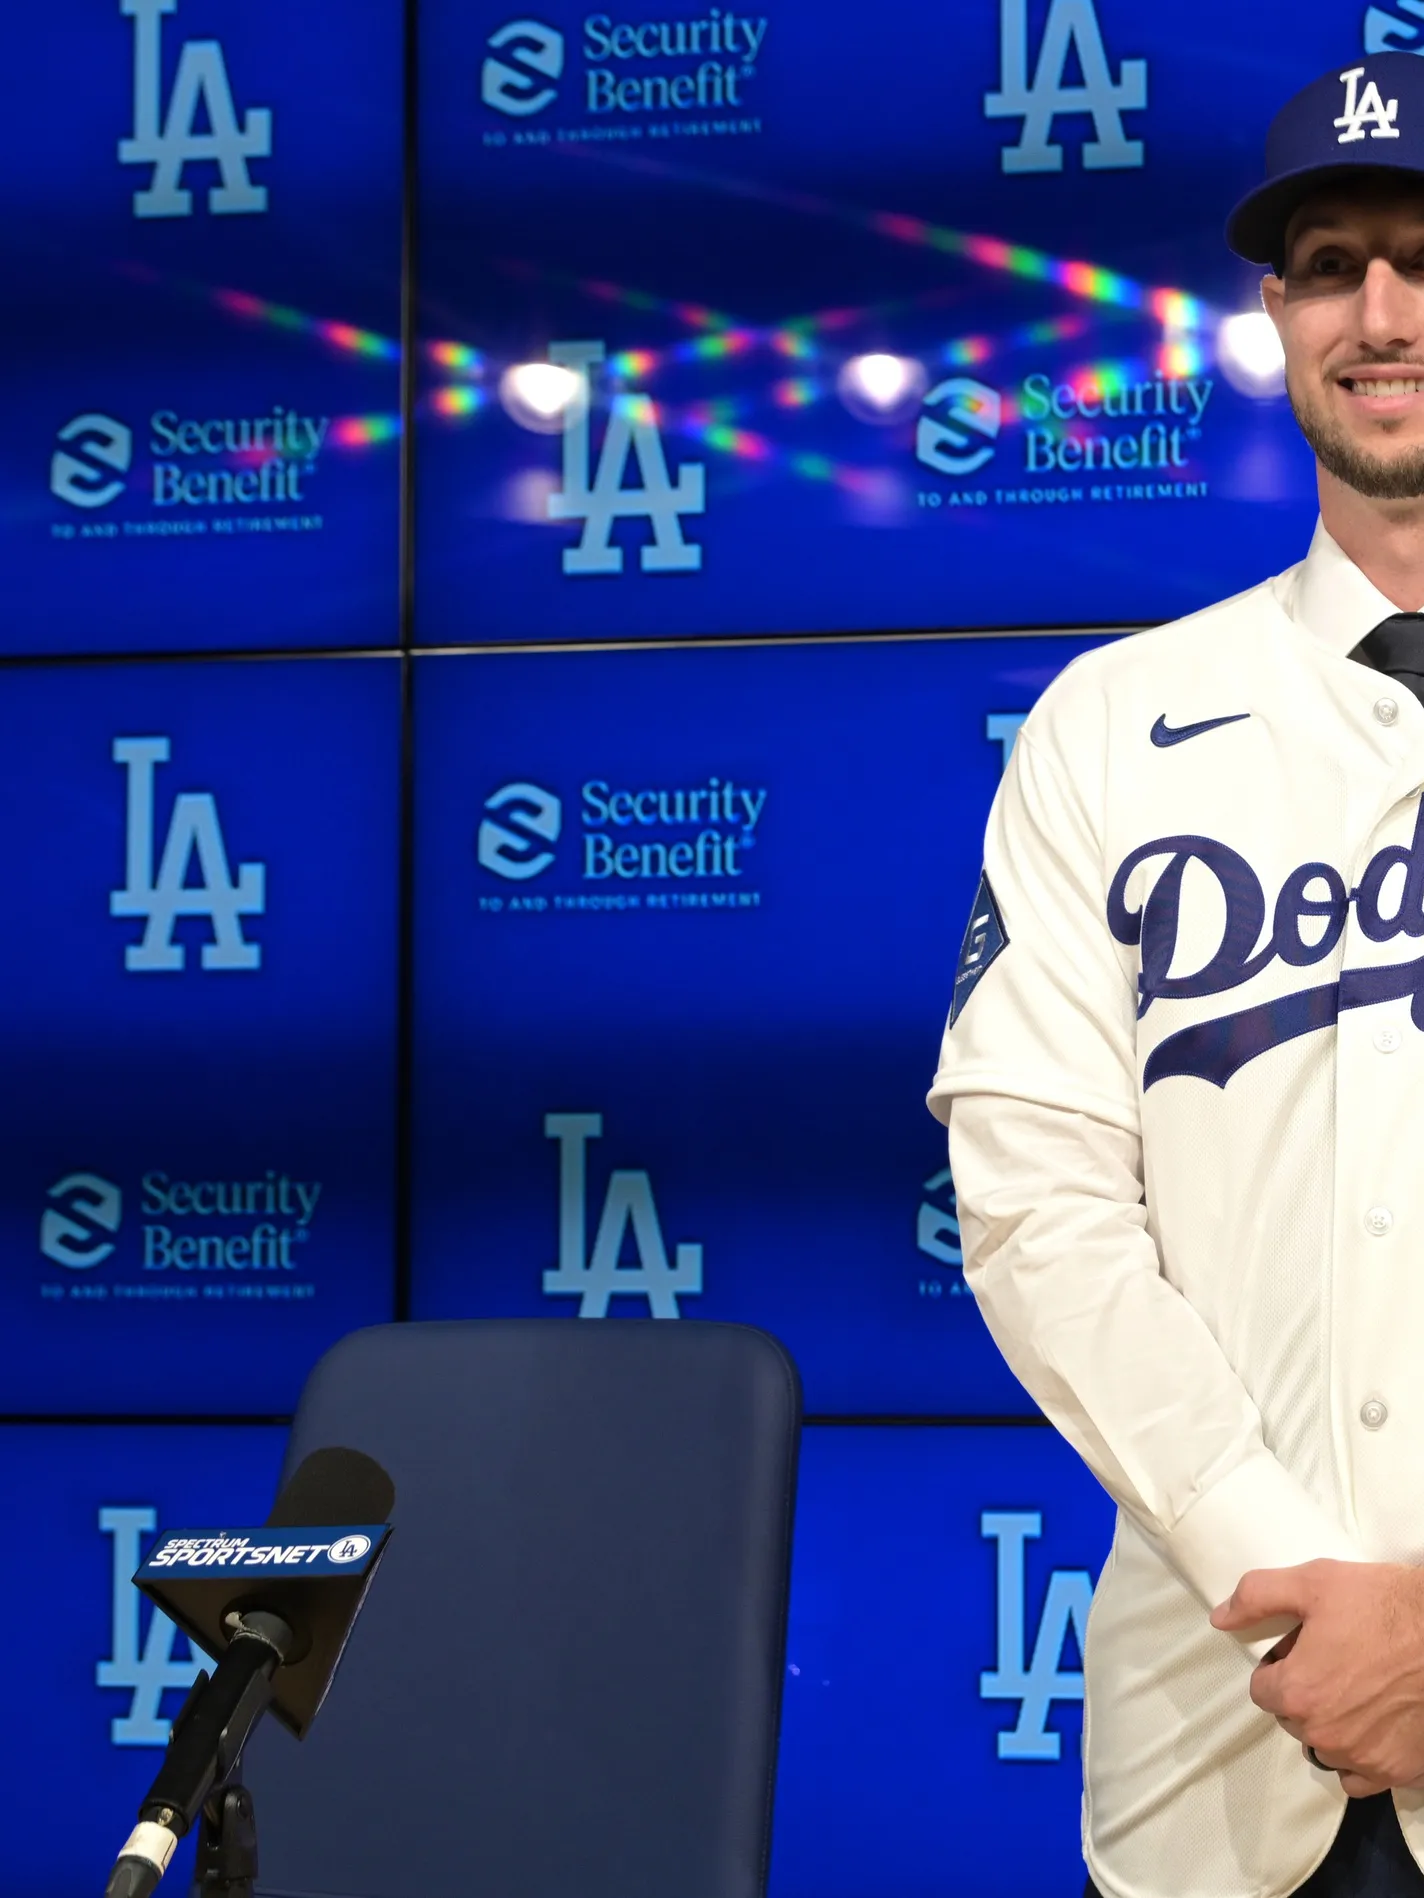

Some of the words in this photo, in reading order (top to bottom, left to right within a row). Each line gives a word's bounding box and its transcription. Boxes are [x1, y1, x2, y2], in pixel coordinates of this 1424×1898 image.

[584, 7, 768, 61] Security
[119, 0, 271, 217] LA
[1333, 66, 1400, 144] LA
[1022, 369, 1213, 424] Security
[151, 405, 329, 459] Security
[548, 342, 704, 573] LA
[917, 491, 941, 507] TO
[949, 490, 987, 506] AND
[996, 487, 1083, 504] THROUGH
[1091, 482, 1207, 500] RETIREMENT
[582, 777, 766, 829] Security
[111, 737, 264, 971] LA
[142, 1170, 322, 1225] Security
[542, 1113, 702, 1319] LA
[149, 1544, 330, 1567] SPORTSNET
[339, 1540, 357, 1557] LA
[164, 1538, 249, 1549] SPECTRUM
